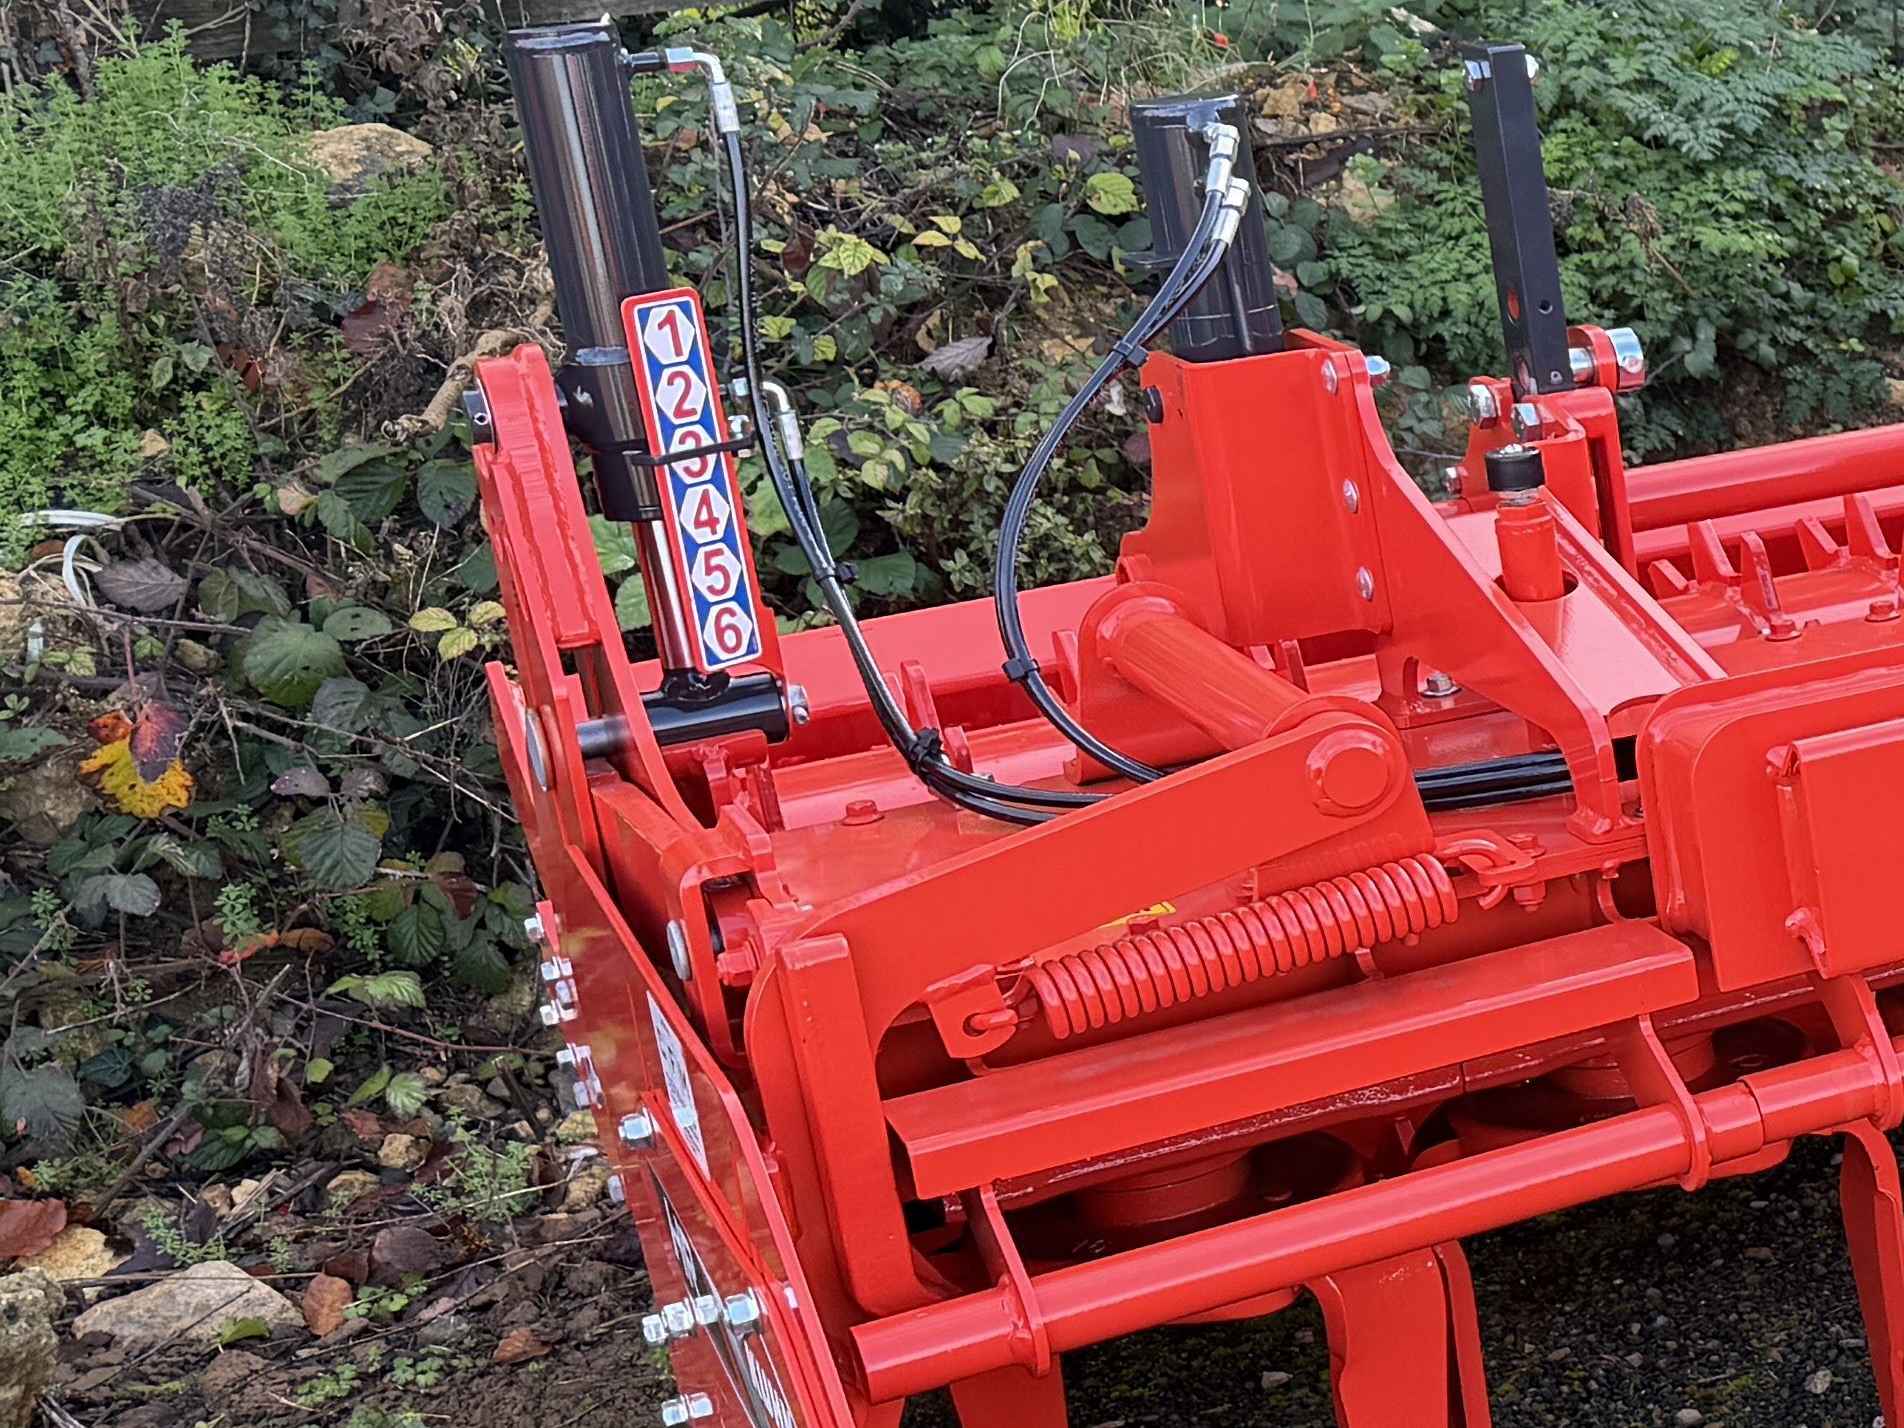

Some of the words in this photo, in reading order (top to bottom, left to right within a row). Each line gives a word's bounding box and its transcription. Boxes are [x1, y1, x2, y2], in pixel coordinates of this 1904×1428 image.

[658, 309, 684, 357] 1
[666, 370, 697, 419] 2
[679, 430, 708, 479] 3
[694, 489, 720, 535] 4
[704, 548, 732, 597] 5
[715, 607, 743, 655] 6
